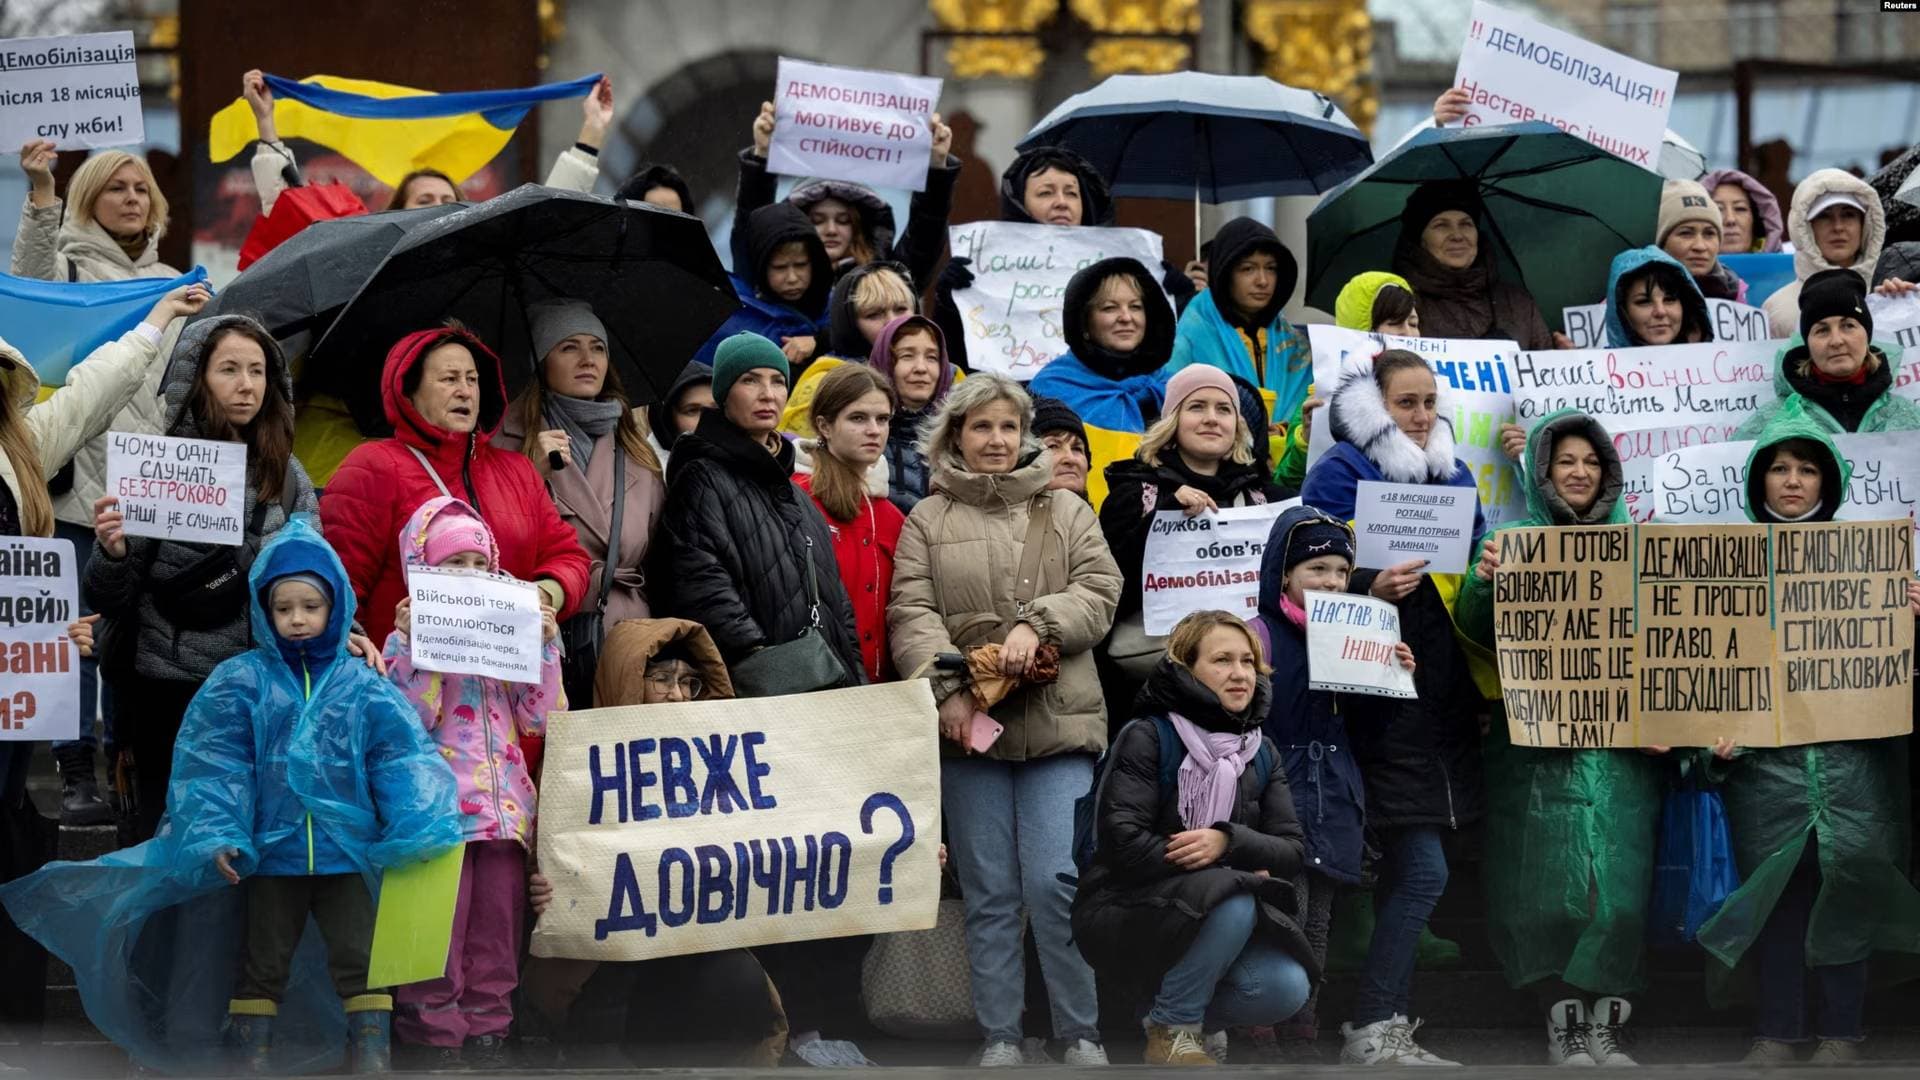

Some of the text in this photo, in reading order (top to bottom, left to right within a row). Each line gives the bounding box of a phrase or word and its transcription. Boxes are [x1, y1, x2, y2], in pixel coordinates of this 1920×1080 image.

[51, 87, 71, 103] 18
[75, 82, 141, 101] місяців
[786, 81, 929, 113] ДЕМОБІЛІЗАЦІЯ
[794, 111, 915, 141] МОТИВУЄ ДО
[800, 138, 891, 162] СТІЙКОСТІ
[957, 228, 1055, 273] Наші
[1513, 353, 1605, 388] Наші
[115, 435, 220, 464] ЧОМУ ОДНІ
[1662, 453, 1714, 491] За
[119, 477, 227, 506] БЕЗСТРОКОВО
[1400, 493, 1438, 505] МІСЯЦІВ
[1439, 496, 1455, 505] БЕЗ
[168, 511, 183, 526] НЕ
[1152, 515, 1211, 535] Служба
[1367, 523, 1460, 538] ХЛОПЦЯМ ПОТРІБНА
[1500, 528, 1629, 564] МИ ГОТОВІ
[1639, 533, 1769, 581] ДЕМОБІЛІЗАЦІЯ
[1775, 523, 1911, 576] ДЕМОБІЛІЗАЦІЯ
[416, 588, 515, 612] Військові теж
[1496, 570, 1603, 603] ВОЮВАТИ В
[1653, 585, 1767, 617] НЕ ПРОСТО
[1781, 577, 1910, 613] МОТИВУЄ ДО
[417, 614, 515, 636] втомлюються
[1310, 599, 1398, 633] НАСТАВ ЧАС
[1563, 607, 1600, 640] АЛЕ
[1609, 607, 1634, 640] НЕ
[1784, 612, 1894, 652] СТІЙКОСТІ
[416, 633, 520, 656] #демобілізацію через
[1725, 627, 1739, 659] А
[418, 649, 528, 672] 18 місяців за бажанням
[1499, 645, 1634, 683] ГОТОВІ ЩОБ ЦЕ
[1787, 648, 1912, 693] ВІЙСЬКОВИХ!
[1504, 686, 1629, 724] РОБИЛИ ОДНІ Й
[1640, 664, 1772, 714] НЕОБХІДНІСТЬ!
[588, 731, 777, 825] НЕВЖЕ
